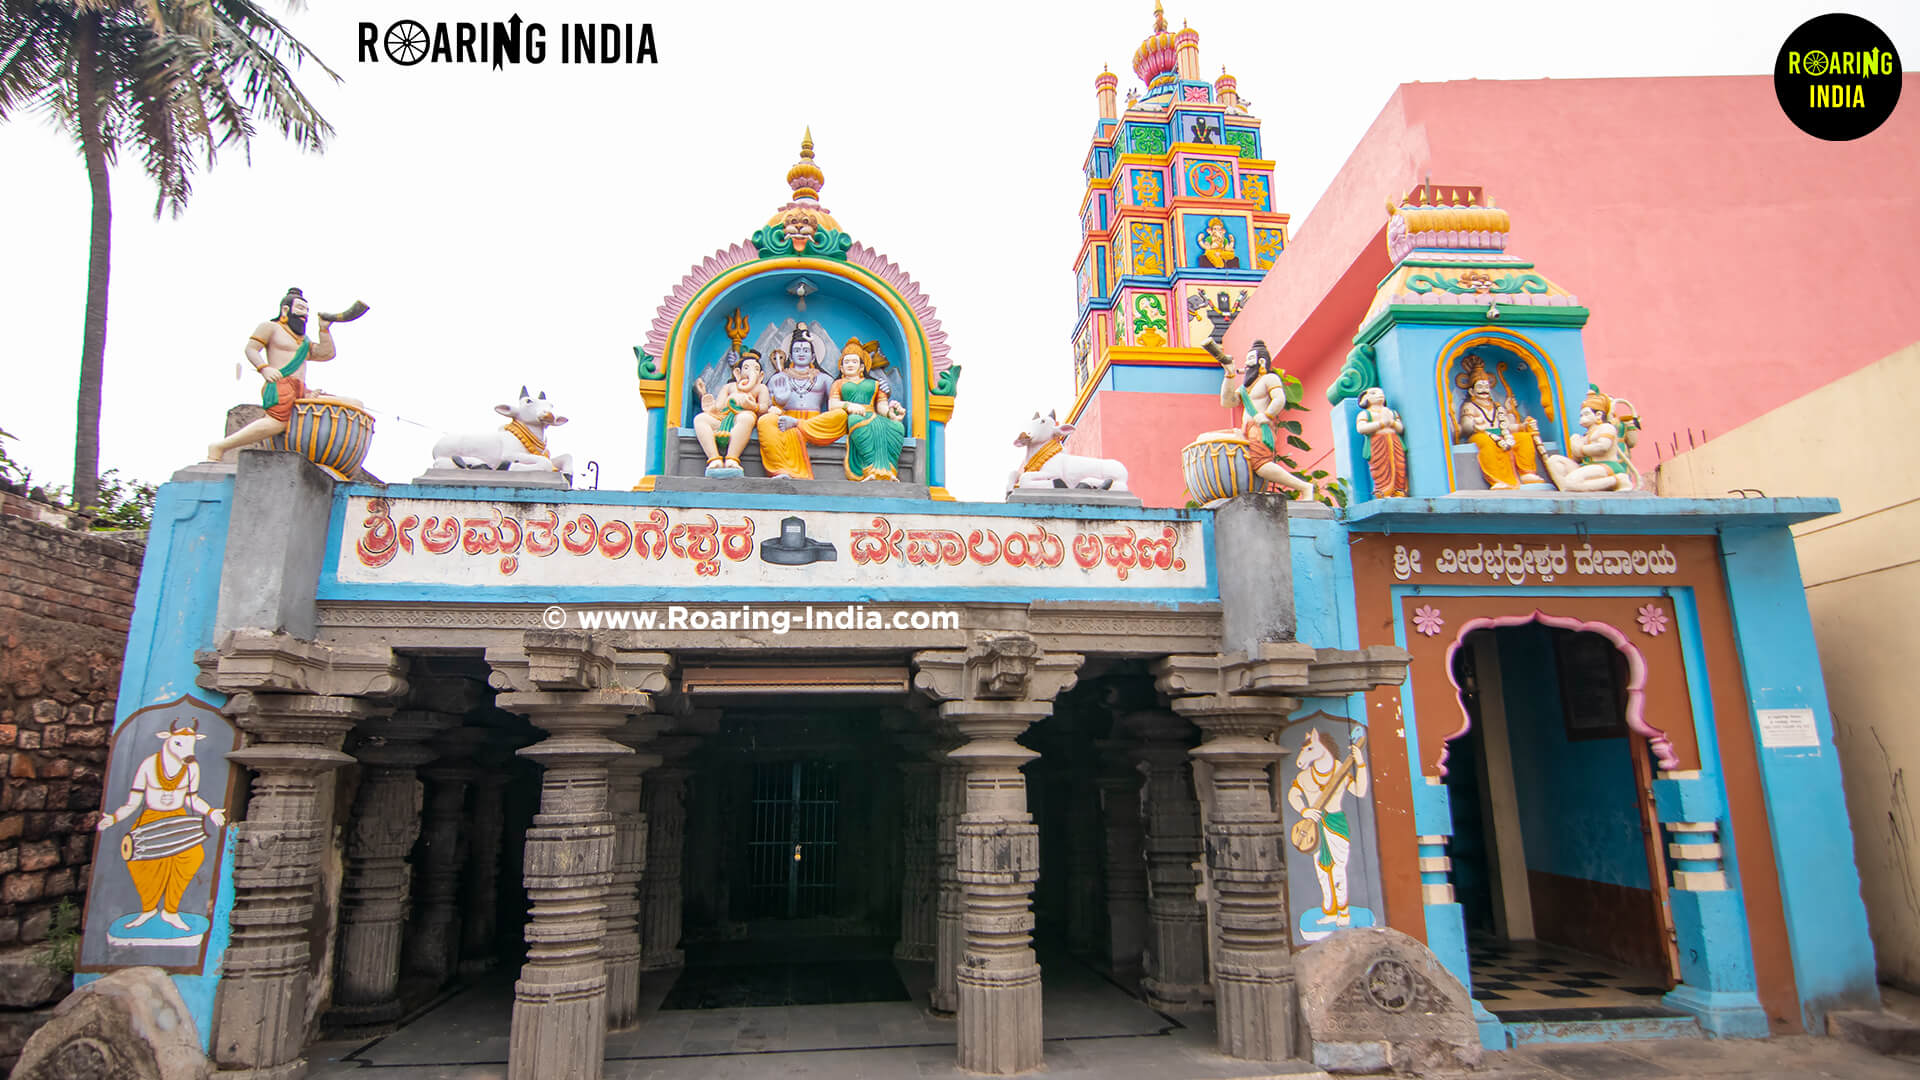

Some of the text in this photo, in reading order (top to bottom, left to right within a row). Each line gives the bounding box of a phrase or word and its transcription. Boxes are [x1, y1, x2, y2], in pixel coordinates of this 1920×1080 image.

[849, 516, 1065, 569] ದೇವಾಲಯ
[1393, 542, 1677, 585] ಶ್ರೀ ವೀರಭದ್ರೇಶ್ವರ ದೇವಾಲಯ
